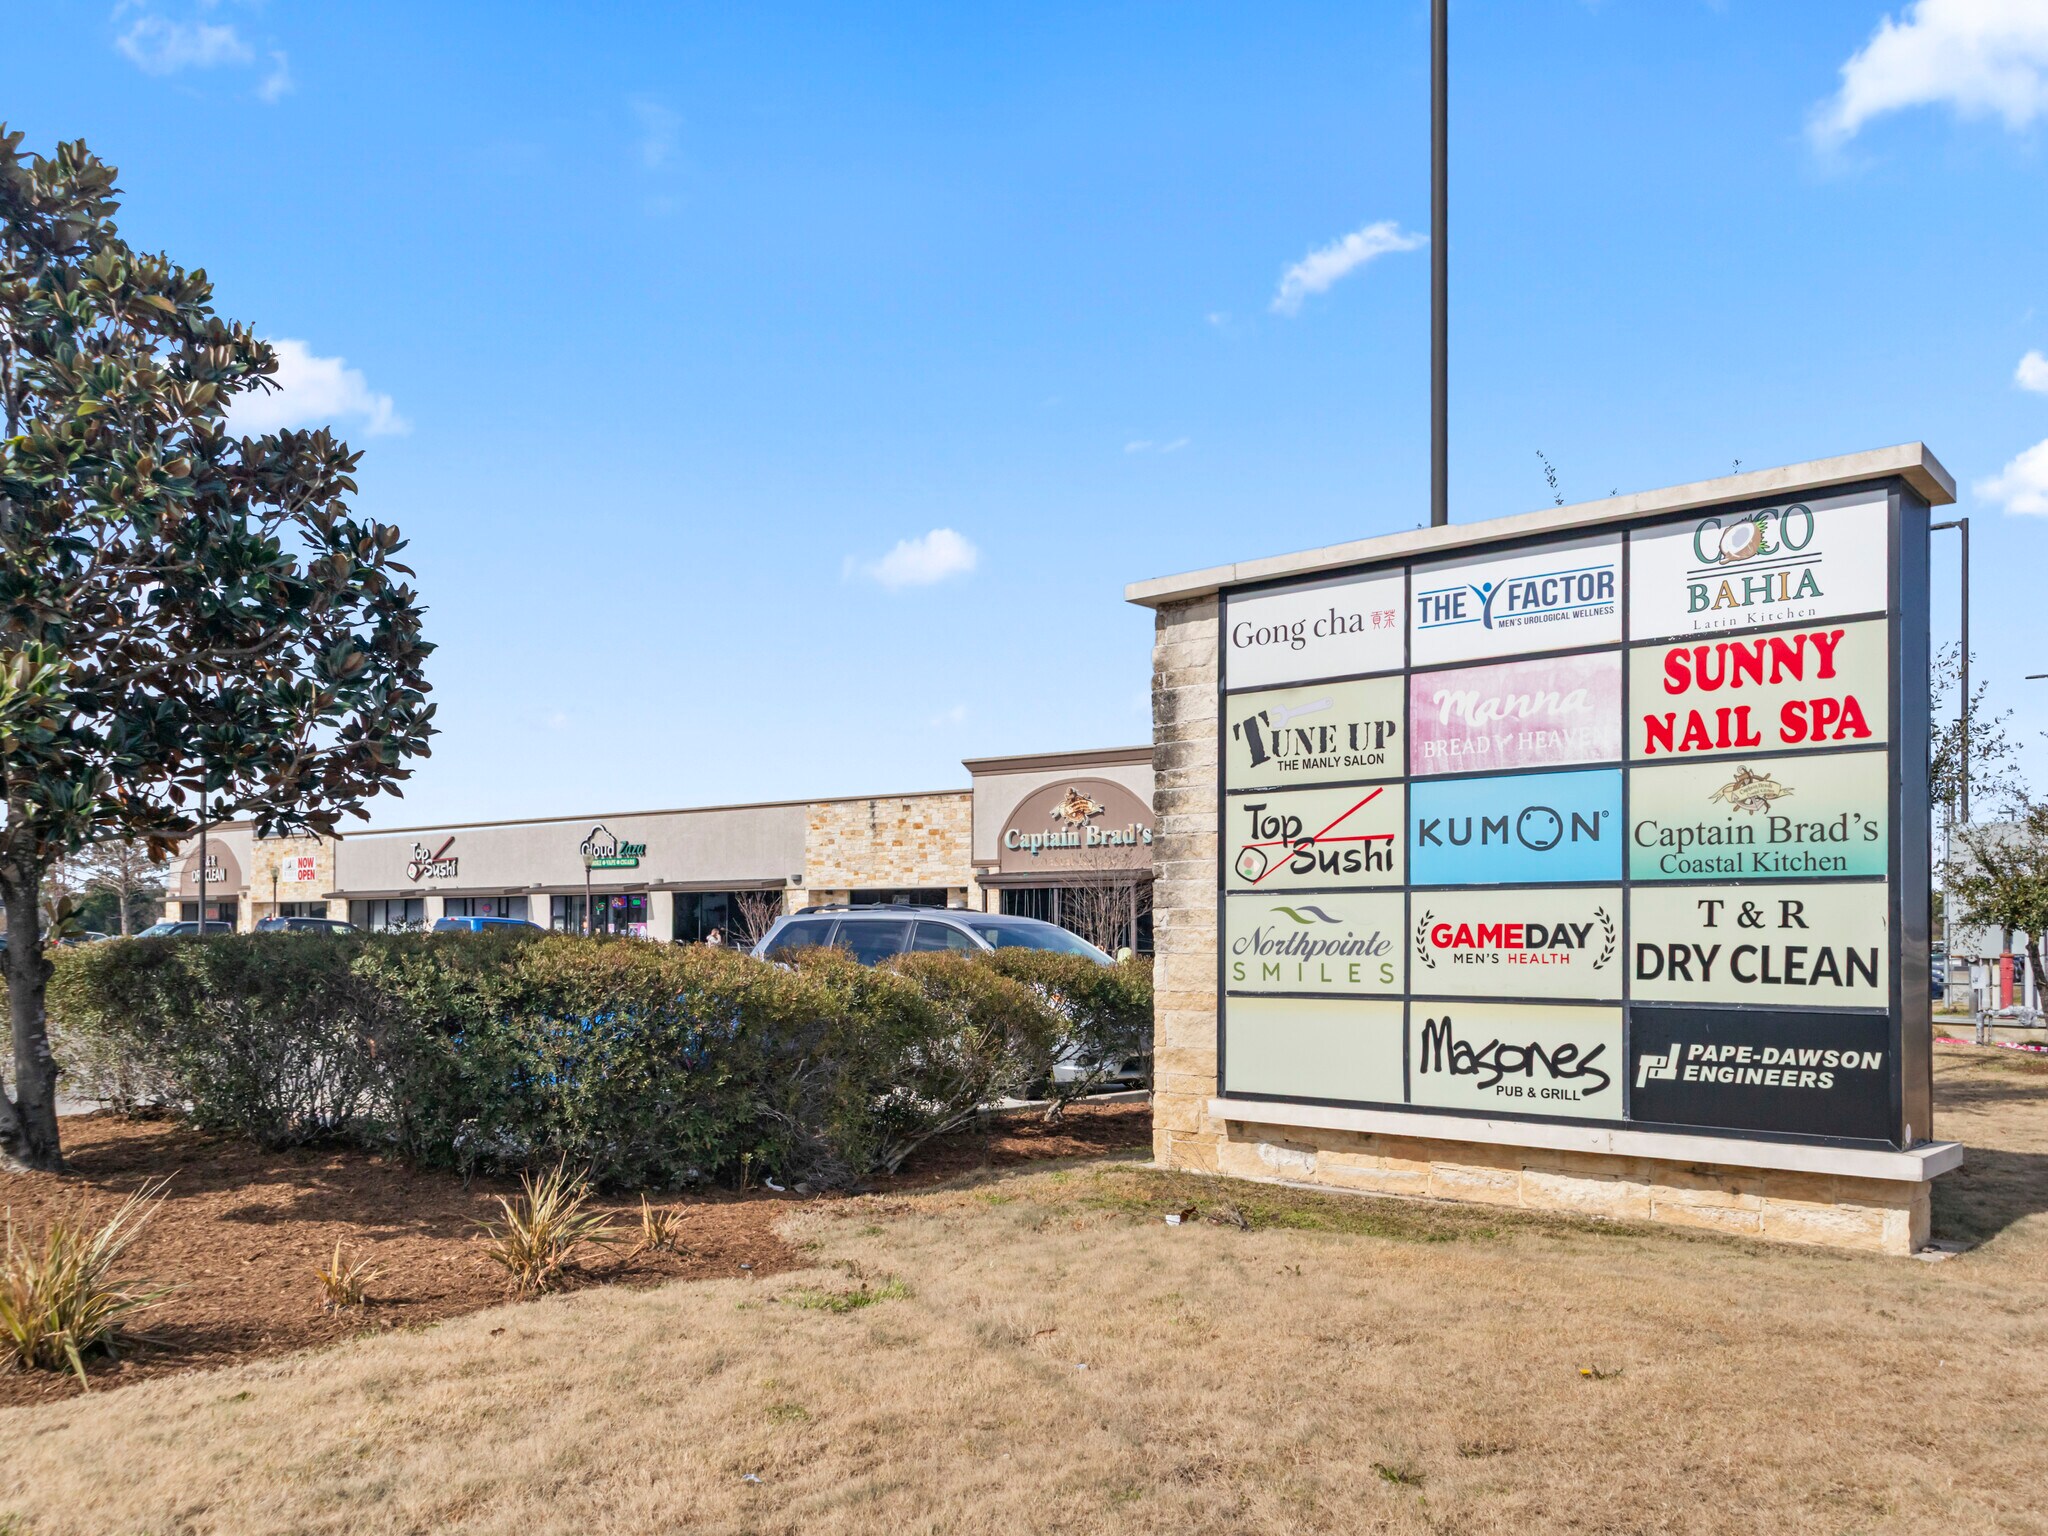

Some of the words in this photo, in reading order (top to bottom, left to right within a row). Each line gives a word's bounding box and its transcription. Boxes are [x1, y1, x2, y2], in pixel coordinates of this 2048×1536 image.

[1417, 591, 1467, 623] THE
[1508, 570, 1614, 611] FACTOR
[1686, 568, 1824, 613] BAHIA
[1232, 618, 1306, 651] Gong
[1313, 607, 1365, 638] cha
[1498, 617, 1522, 629] MEN'S
[1524, 611, 1571, 626] UROLOGICAL
[1572, 606, 1615, 621] WELLNESS
[1693, 618, 1737, 631] Latin
[1747, 607, 1817, 624] Kitchen
[1663, 629, 1845, 695] SUNNY
[1432, 687, 1594, 727] Manna
[1643, 705, 1762, 755] NAIL
[1779, 695, 1872, 744] SPA
[1232, 709, 1337, 769] TUNE
[1347, 720, 1397, 752] UP
[1423, 736, 1491, 758] BREAD
[1277, 759, 1299, 772] THE
[1302, 755, 1341, 770] MANLY
[1343, 752, 1385, 767] SALON
[1004, 827, 1081, 856] Captain
[1086, 823, 1153, 848] Brad's
[1243, 803, 1303, 849] Top
[1634, 815, 1754, 854] Captain
[1766, 812, 1879, 844] Brad's
[211, 856, 218, 867] R
[410, 843, 431, 864] Top
[581, 840, 617, 857] Cloud
[1289, 836, 1394, 876] Sushi
[205, 868, 226, 882] CLEAN
[297, 857, 315, 869] NOW
[297, 869, 315, 880] OPEN
[423, 858, 458, 878] Sushi
[1659, 853, 1743, 874] Coastal
[1752, 851, 1848, 872] Kitchen
[1697, 900, 1725, 928] T
[1736, 901, 1766, 928] &
[1778, 900, 1810, 929] R
[1232, 925, 1394, 962] Northpointe
[1430, 922, 1595, 950] GAMEDAY
[1453, 952, 1499, 965] MEN'S
[1507, 953, 1571, 965] HEALTH
[1636, 943, 1722, 983] DRY
[1730, 945, 1879, 988] CLEAN
[1232, 961, 1395, 985] SMILES
[1419, 1015, 1611, 1096] Masones
[1687, 1044, 1883, 1071] PAPE-DAWSON
[1682, 1065, 1835, 1090] ENGINEERS
[1496, 1085, 1523, 1099] PUB
[1527, 1086, 1538, 1099] &
[1540, 1087, 1582, 1102] GRILL
